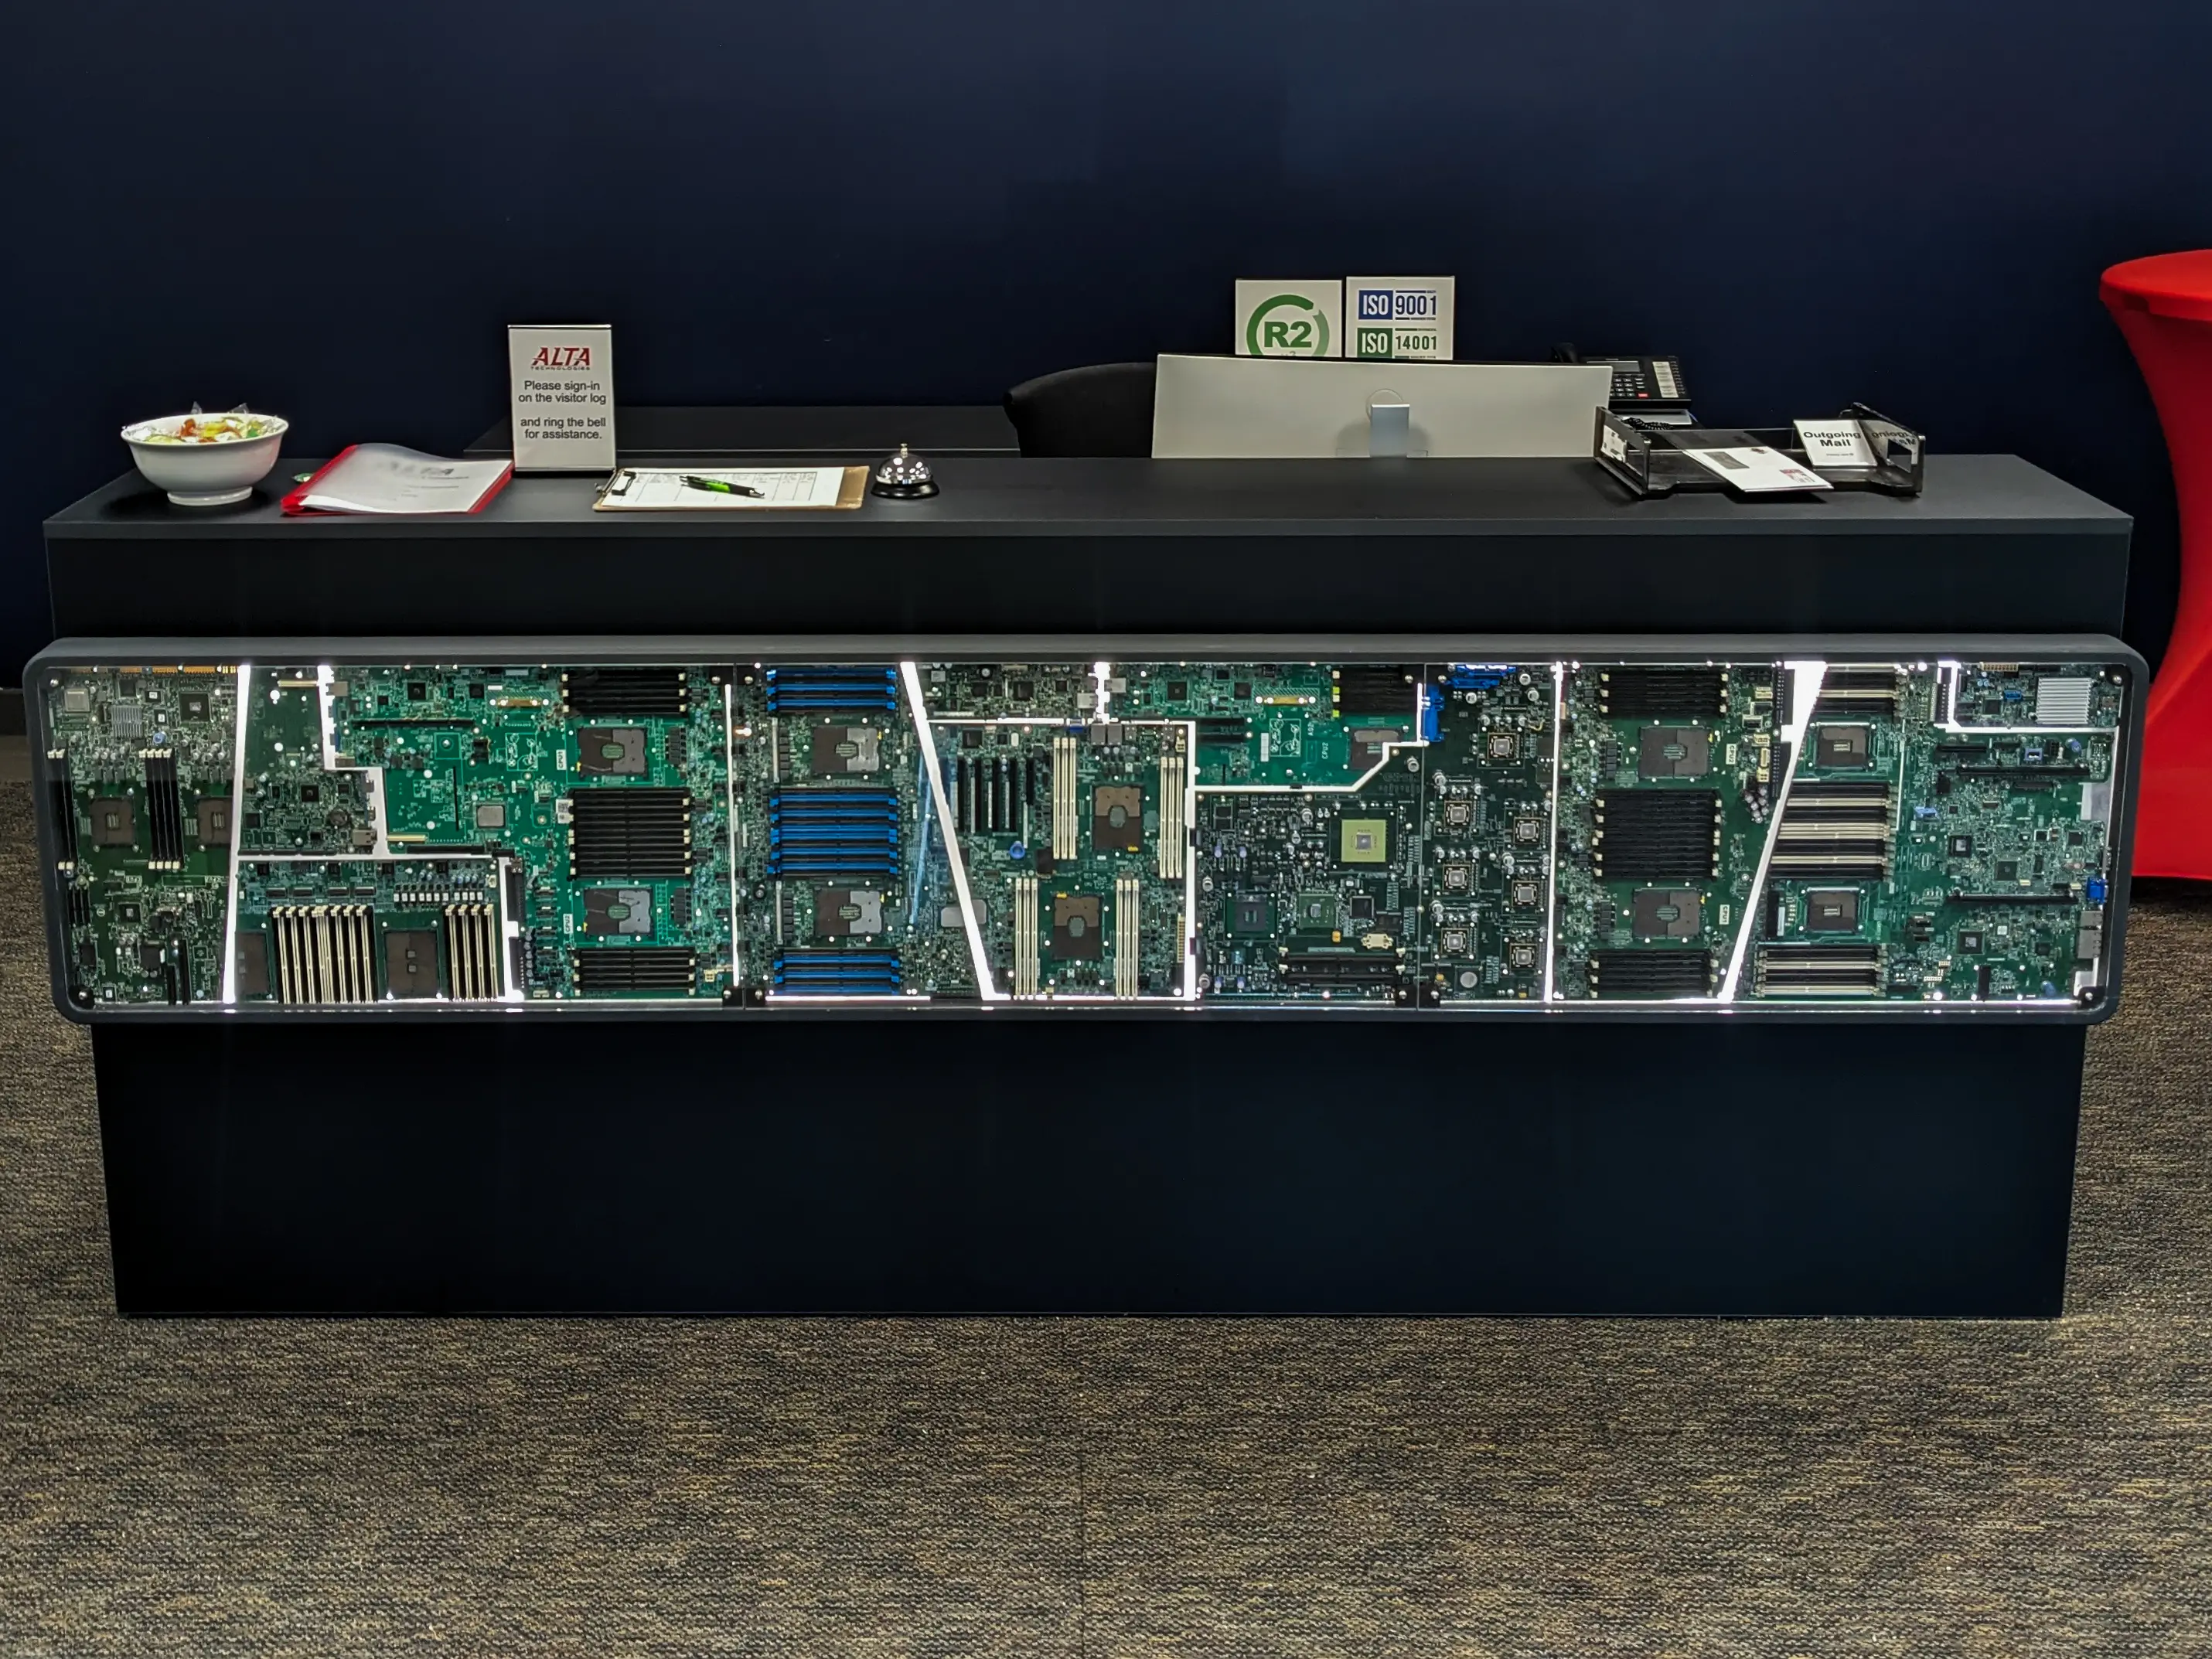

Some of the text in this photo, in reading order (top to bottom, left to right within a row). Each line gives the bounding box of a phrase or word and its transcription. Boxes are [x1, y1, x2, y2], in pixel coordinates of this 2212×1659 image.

[1363, 295, 1437, 315] ISO 9001
[1264, 321, 1312, 348] R2
[1362, 332, 1437, 353] ISO 14001
[531, 347, 590, 366] ALTA
[524, 380, 600, 393] Please sign-in
[536, 393, 552, 402] the
[555, 393, 588, 402] visitor
[590, 393, 607, 405] log
[520, 417, 606, 429] and ring the bell
[525, 429, 602, 439] for assistance.
